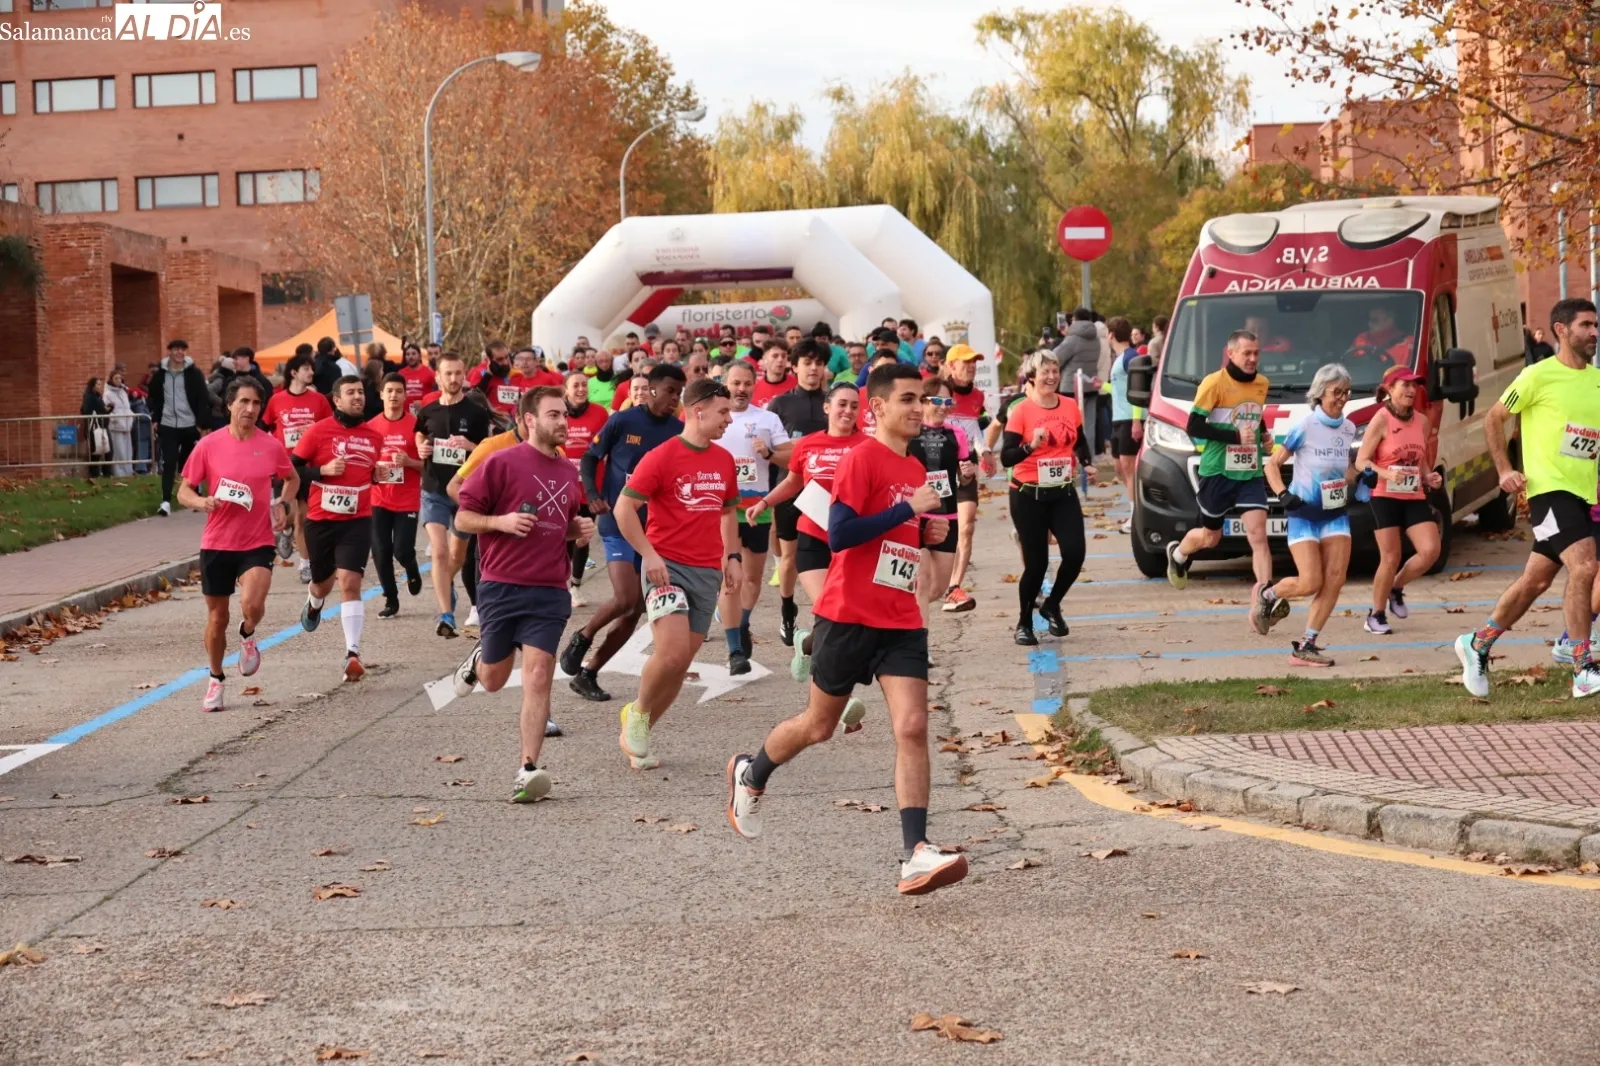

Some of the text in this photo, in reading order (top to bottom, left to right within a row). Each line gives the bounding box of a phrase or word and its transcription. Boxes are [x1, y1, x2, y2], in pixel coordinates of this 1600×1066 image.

[502, 391, 515, 400] 212
[1571, 436, 1596, 453] 472
[440, 448, 459, 459] 106
[1233, 453, 1253, 464] 385
[1314, 448, 1349, 458] INFINIT
[1049, 467, 1063, 478] 58
[228, 489, 245, 499] 59
[329, 495, 351, 507] 476
[890, 559, 914, 580] 143
[652, 593, 677, 611] 279
